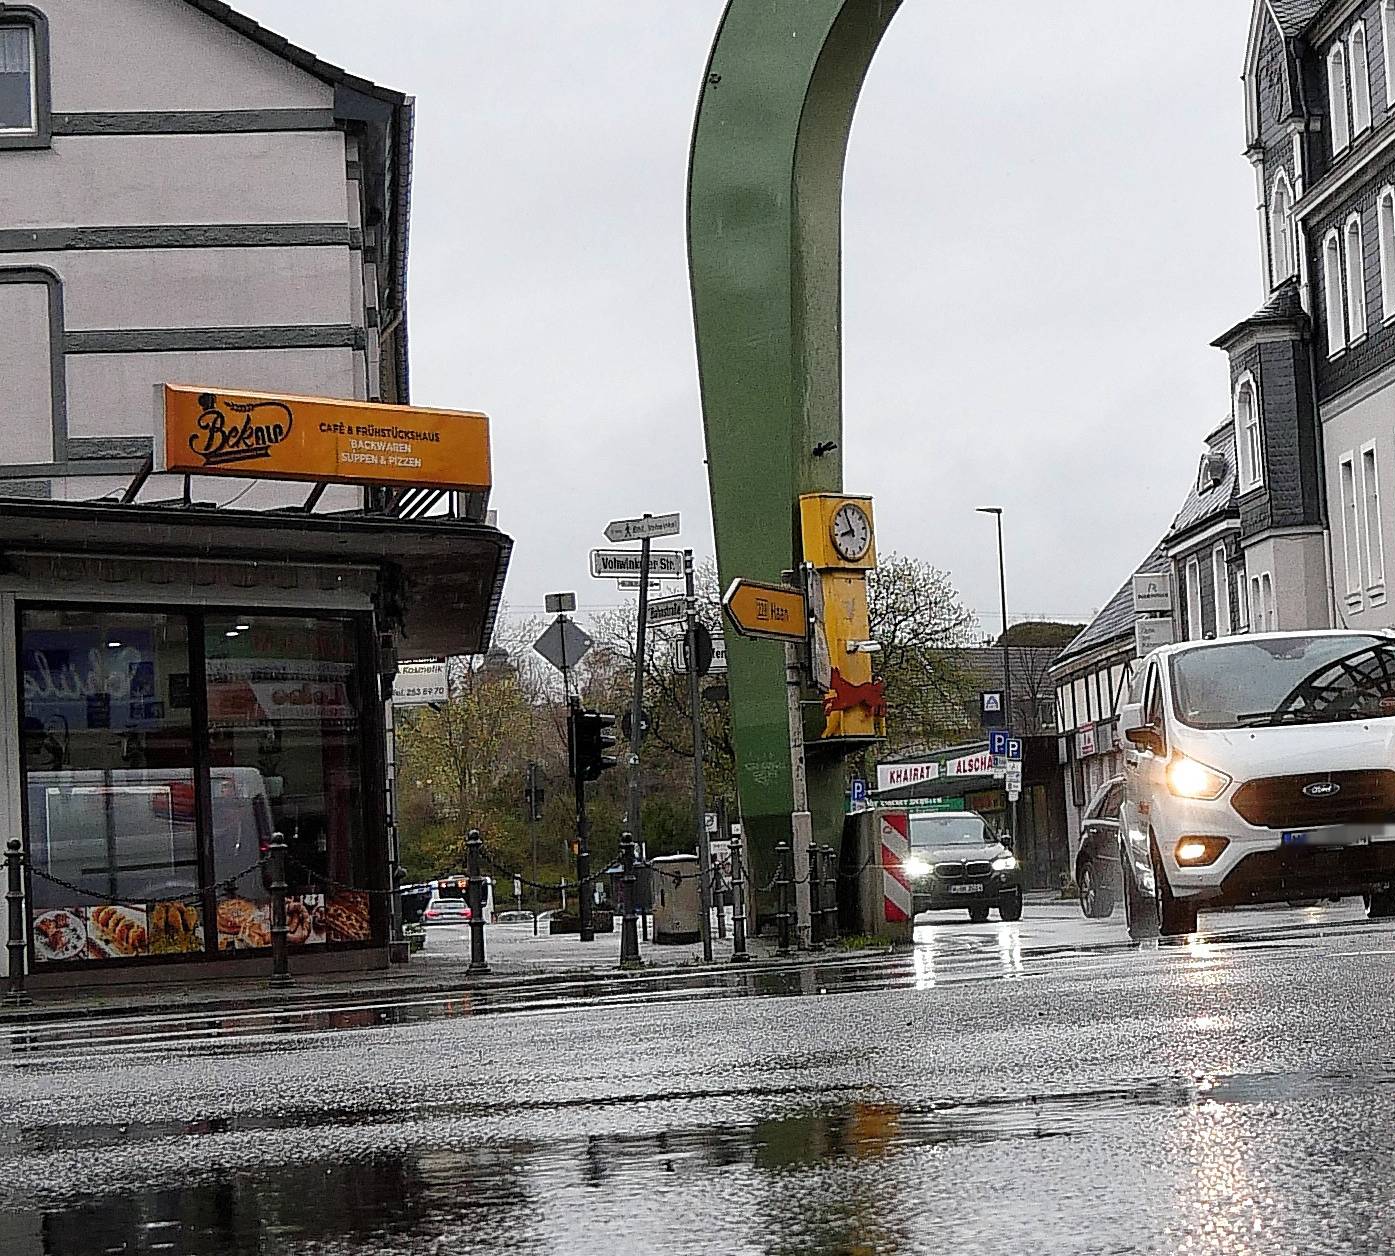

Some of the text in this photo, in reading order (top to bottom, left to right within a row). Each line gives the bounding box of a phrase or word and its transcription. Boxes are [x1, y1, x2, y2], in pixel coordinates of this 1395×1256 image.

[356, 424, 441, 442] FRÜHSTÜCKSHAUS
[350, 439, 412, 453] BACKWAREN
[341, 452, 378, 465] SUPPEN
[389, 456, 422, 468] PIZZEN
[601, 556, 676, 571] Vohwinker Str.
[1009, 741, 1018, 757] P
[889, 765, 931, 785] KHAIRAT
[955, 753, 994, 775] ALSCHA
[854, 781, 863, 798] P
